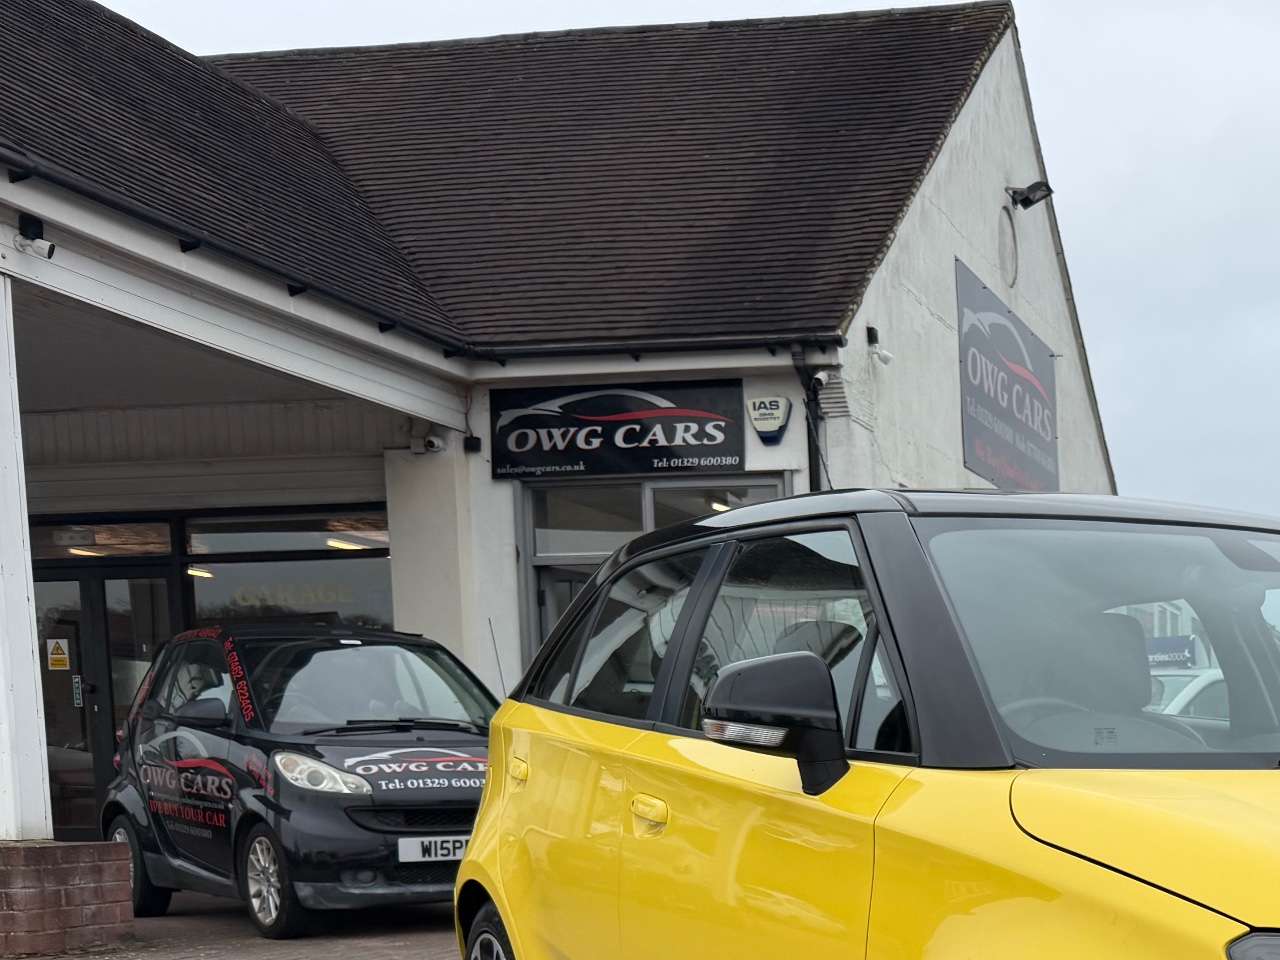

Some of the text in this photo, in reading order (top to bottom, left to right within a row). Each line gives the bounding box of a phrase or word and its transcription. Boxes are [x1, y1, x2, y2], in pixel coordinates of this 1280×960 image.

[967, 347, 1009, 409] OWG
[1012, 384, 1052, 442] CARS
[752, 400, 780, 411] IAS
[506, 420, 726, 453] OWG CARS
[653, 456, 740, 468] Tel: 01329 600380
[355, 761, 489, 775] OWG CAR
[140, 765, 177, 789] OWG
[181, 772, 233, 799] CARS
[378, 778, 486, 790] Tel: 01329 6003
[206, 811, 226, 828] CAR
[421, 840, 470, 858] W15P
